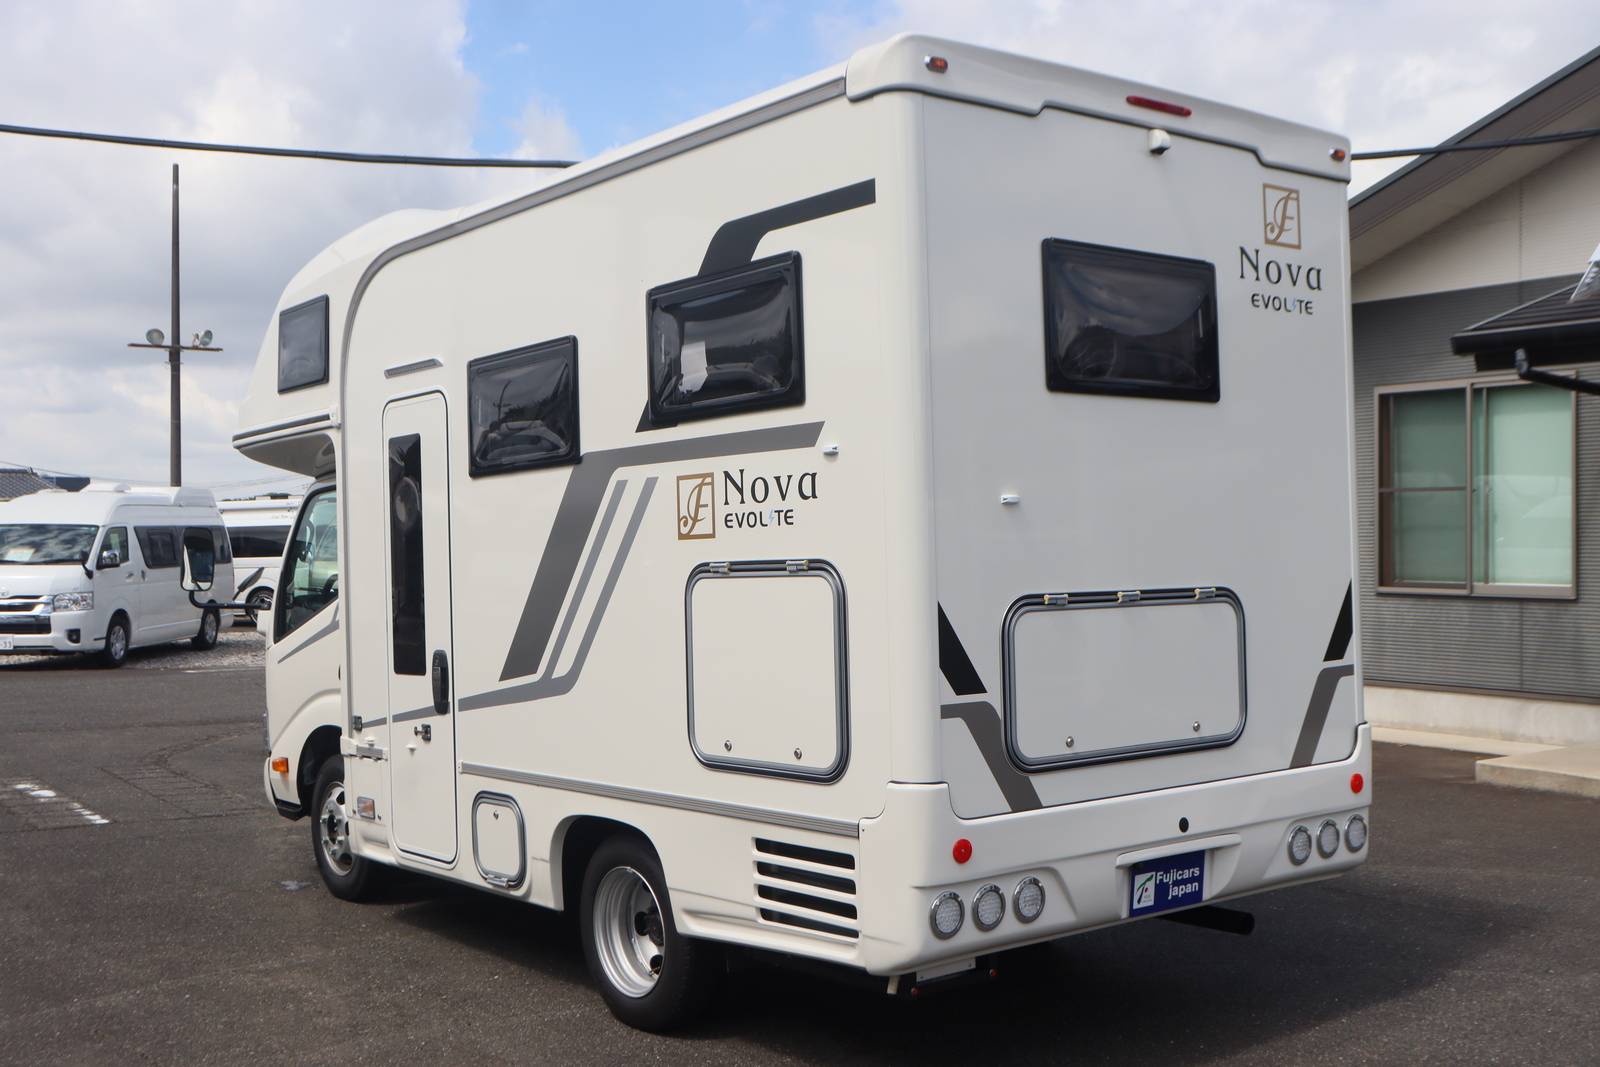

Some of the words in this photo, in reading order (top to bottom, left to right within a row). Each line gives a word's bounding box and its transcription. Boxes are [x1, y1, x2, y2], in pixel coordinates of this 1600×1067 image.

[1239, 245, 1322, 291] Nova
[723, 468, 818, 505] Nova
[1156, 867, 1200, 885] Fujicars
[1167, 882, 1199, 900] japan
